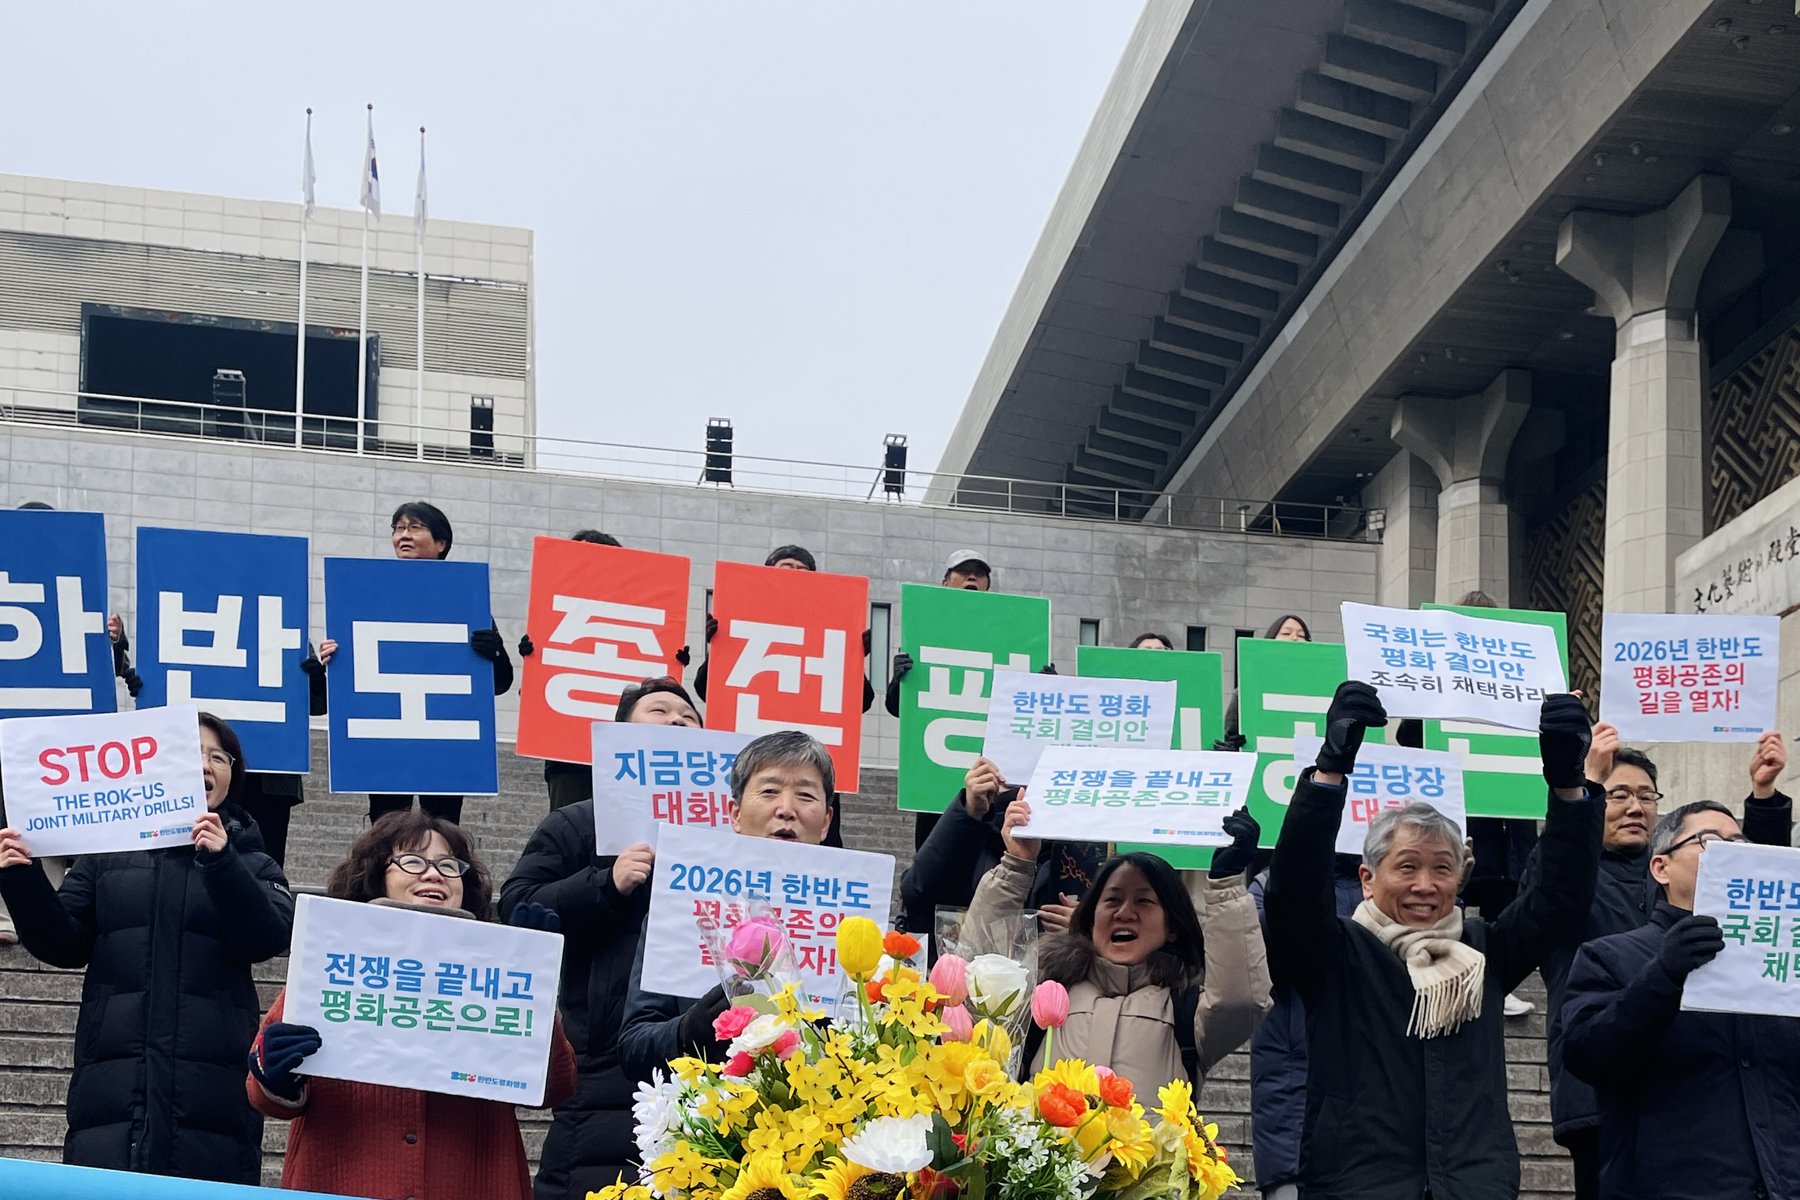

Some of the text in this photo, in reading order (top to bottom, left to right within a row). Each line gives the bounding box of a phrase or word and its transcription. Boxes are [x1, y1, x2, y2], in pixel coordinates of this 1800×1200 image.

[158, 590, 301, 722] 반
[541, 594, 669, 722] 종
[1363, 622, 1537, 660] 국회는 한반도
[1614, 637, 1763, 662] 2026년 한반도
[346, 620, 480, 740] 도
[725, 619, 847, 746] 전
[1369, 670, 1443, 693] 조속히
[1380, 647, 1526, 682] 평화 결의안
[1633, 662, 1745, 689] 평화공존의
[1012, 691, 1152, 718] 한반도 평화
[1639, 689, 1740, 715] 길을 열자!
[1009, 716, 1149, 743] 국회 결의안
[38, 736, 158, 786] STOP
[1050, 769, 1233, 789] 전쟁을 끝내고
[53, 782, 165, 811] THE ROK-US
[1043, 788, 1232, 808] 평화공존으로!
[1351, 762, 1445, 798] 금당장
[26, 796, 195, 832] JOINT MILITARY DRILLS!
[652, 791, 730, 828] 대화!
[669, 863, 872, 909] 2026년 한반도
[1722, 914, 1780, 947] 국회
[324, 952, 534, 1000] 전쟁을 끝내고
[319, 989, 533, 1037] 평화공존으로!
